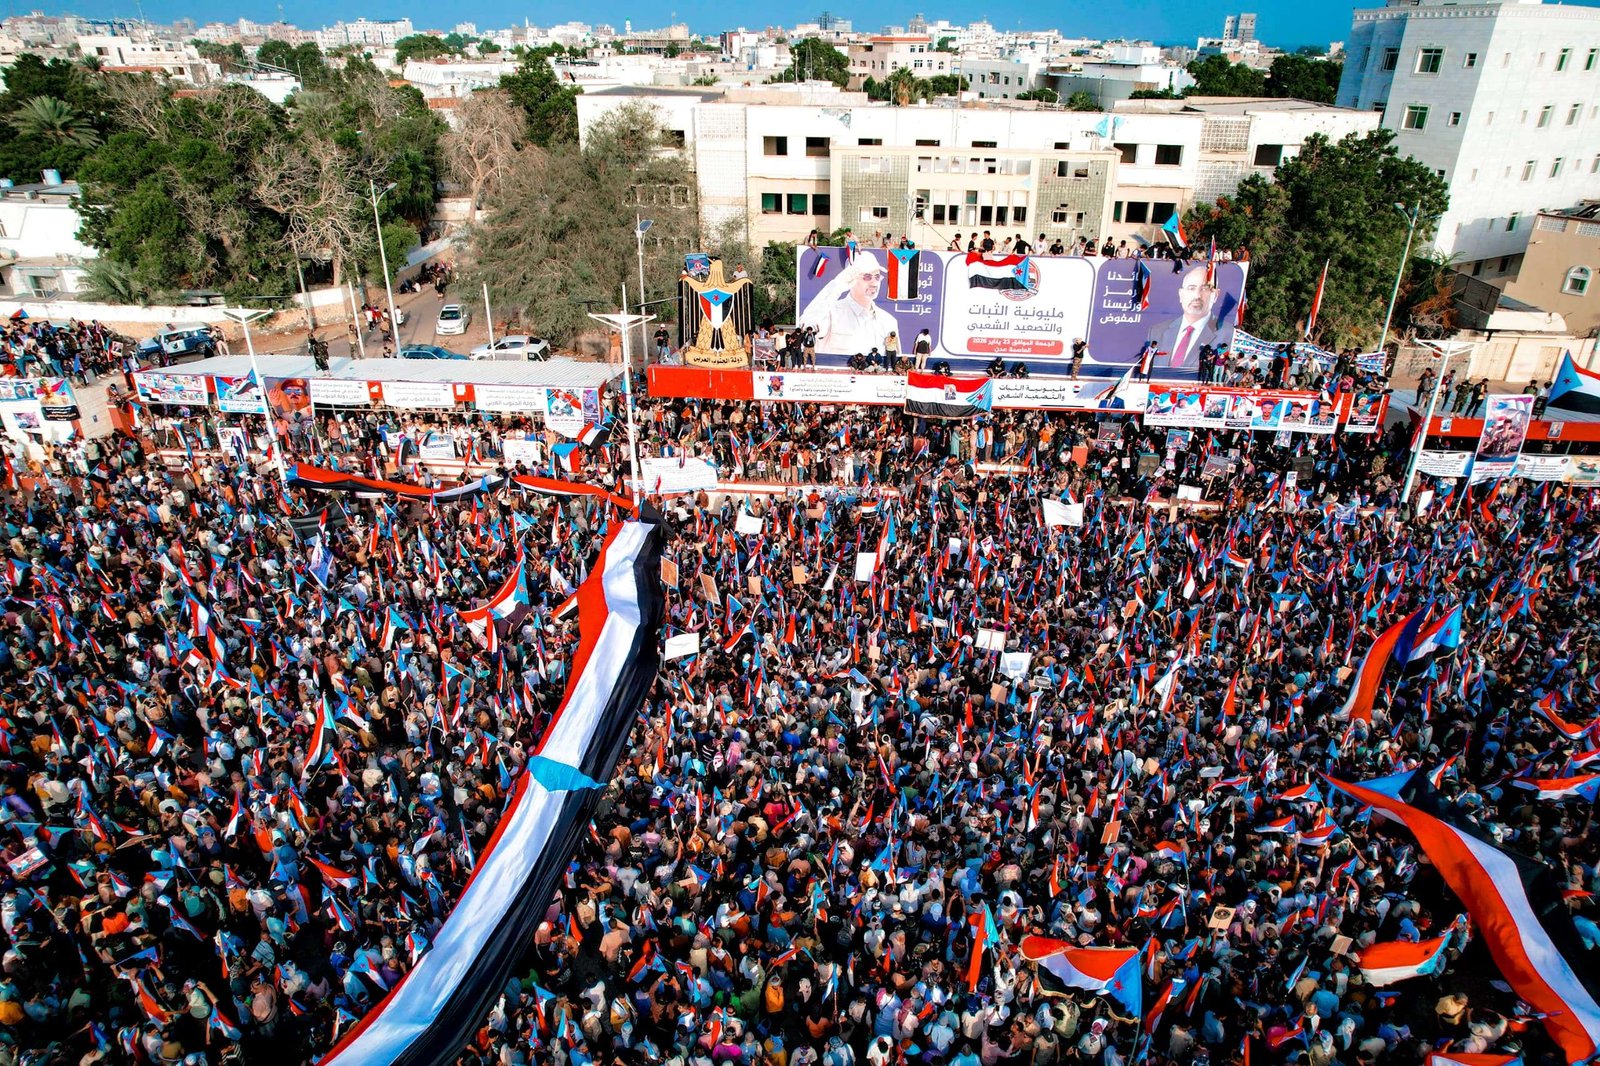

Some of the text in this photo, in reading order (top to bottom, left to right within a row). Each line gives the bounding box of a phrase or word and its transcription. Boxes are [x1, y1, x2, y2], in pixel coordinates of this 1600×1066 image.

[894, 303, 932, 316] عزتنا
[1102, 299, 1142, 312] ورئيسنا
[968, 302, 1064, 321] مليونية الثبات
[1099, 313, 1141, 325] المفوض
[967, 318, 1063, 335] والتصعيد الشعبي
[711, 357, 730, 366] الجنوب
[731, 356, 743, 364] دولة
[998, 384, 1066, 393] مليونية الثبات
[997, 391, 1065, 402] والتصعيد الشعبي
[522, 400, 537, 408] دولة
